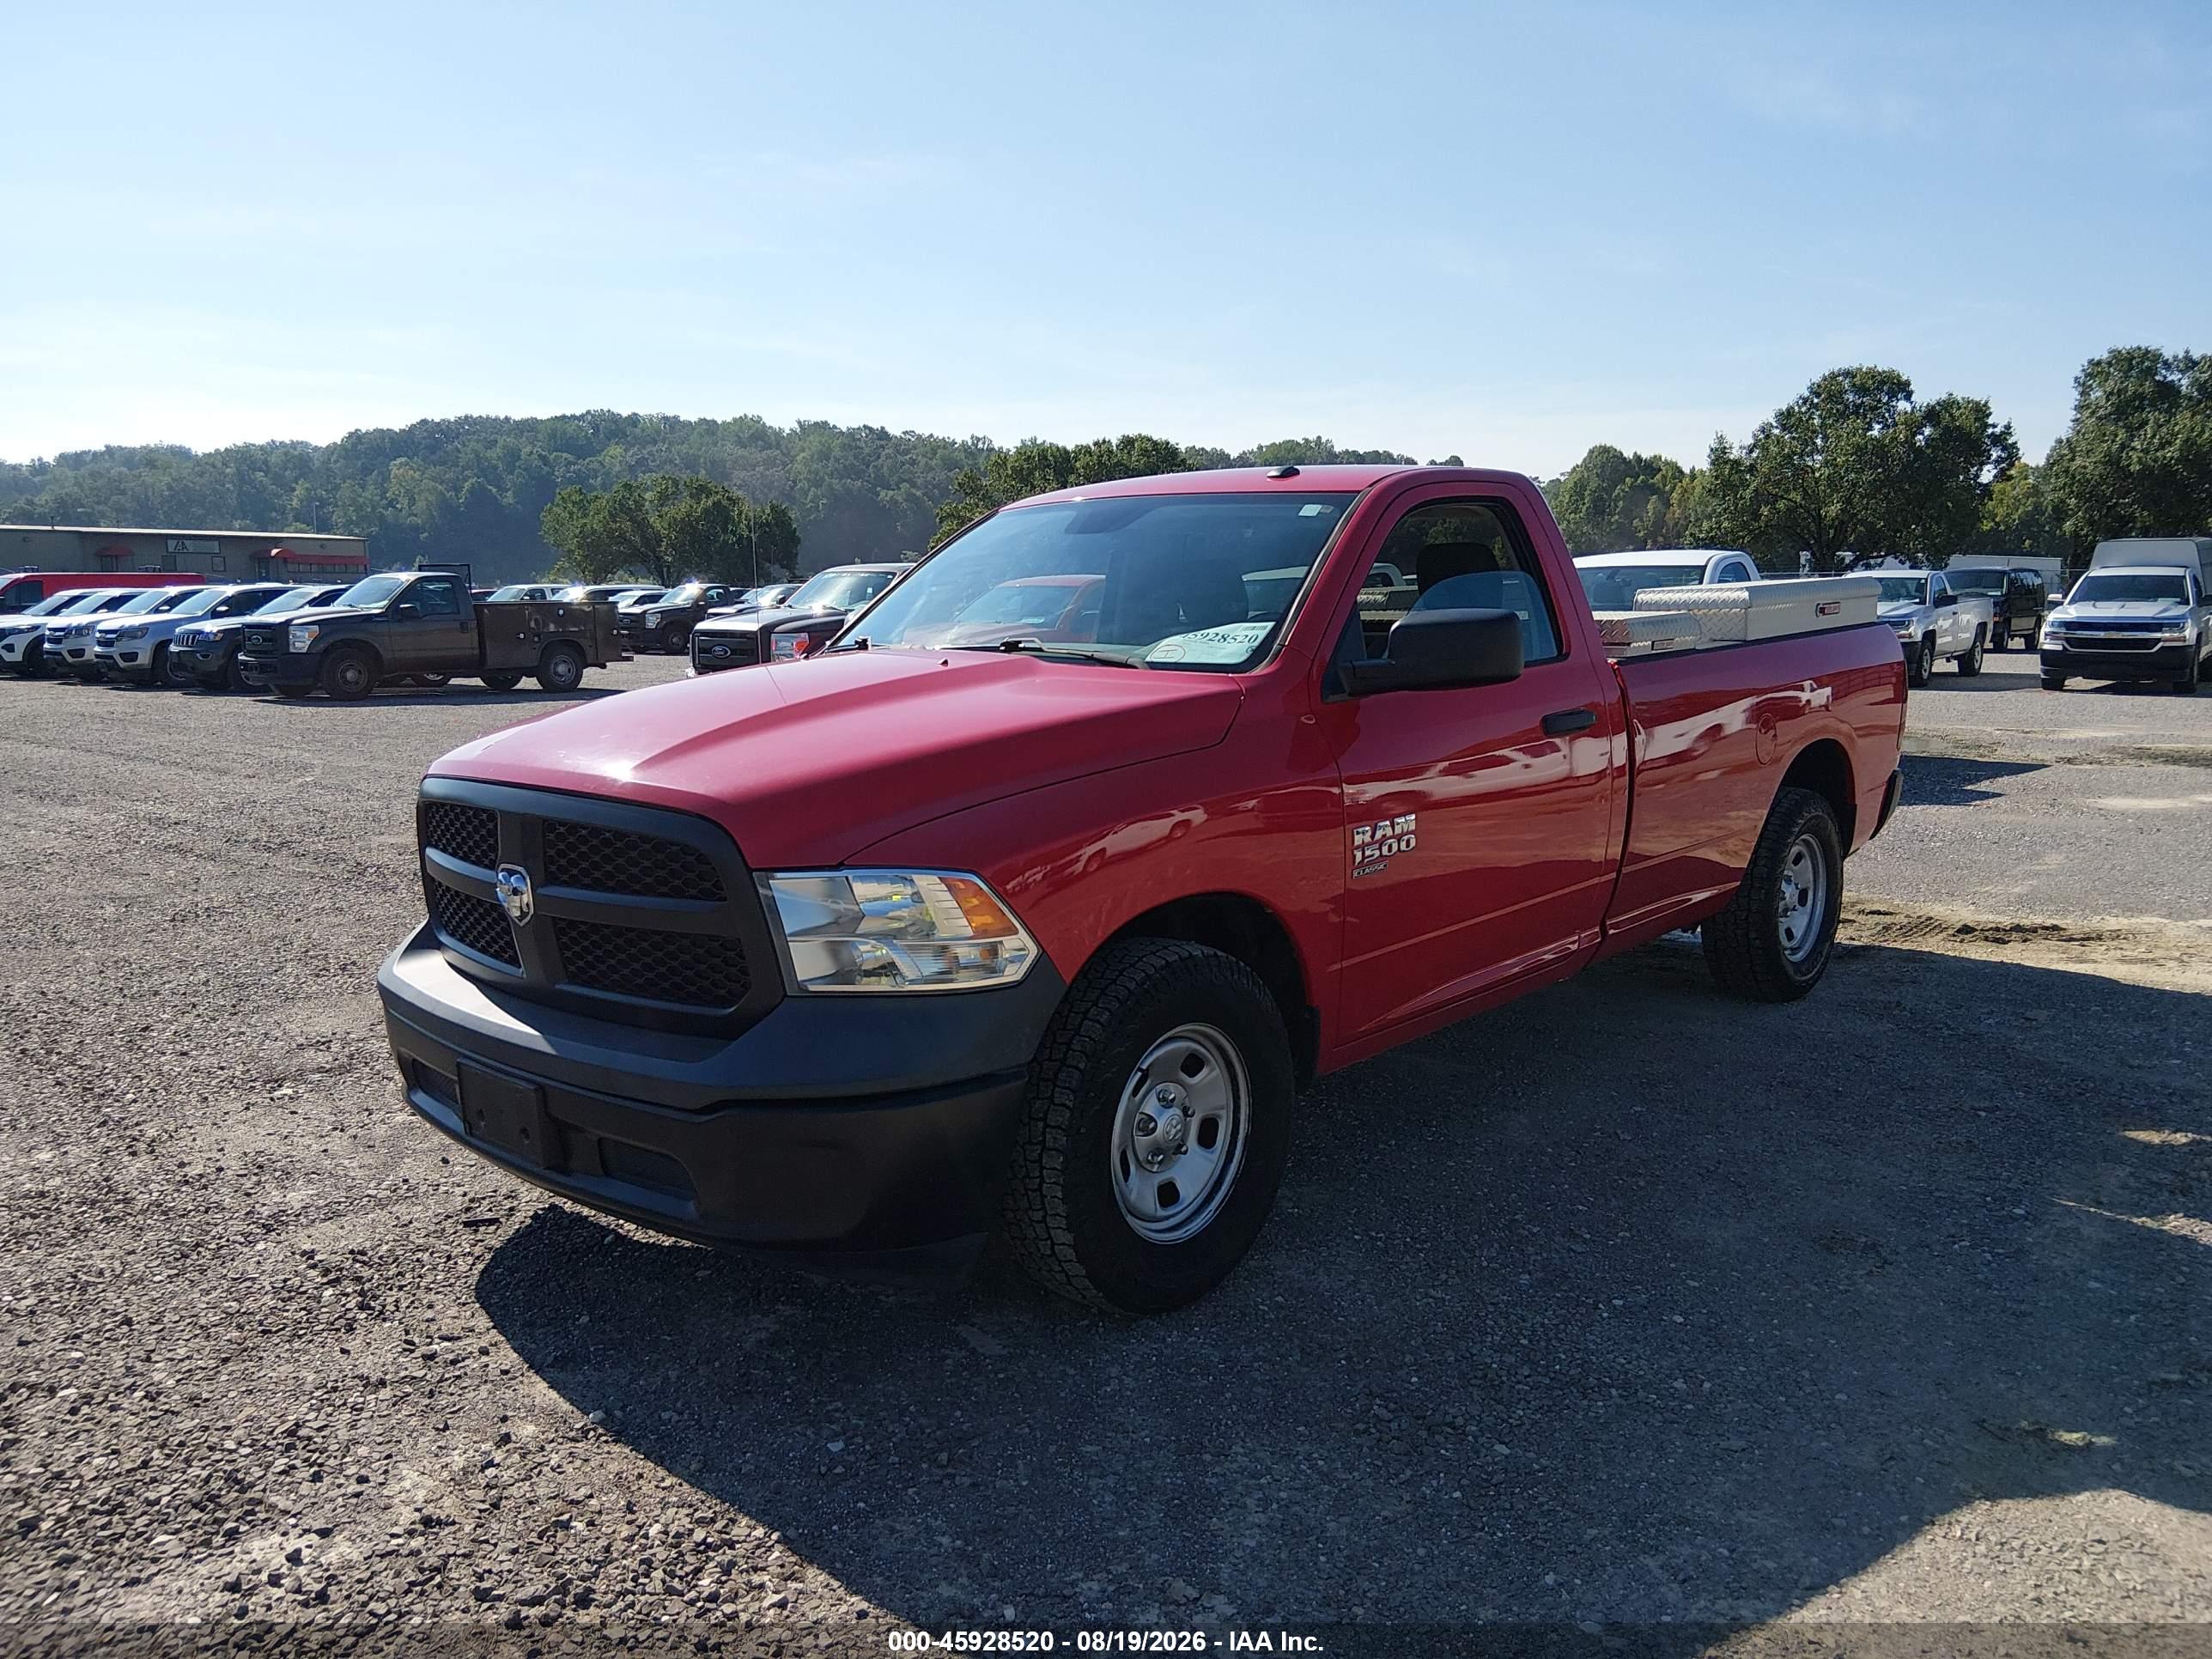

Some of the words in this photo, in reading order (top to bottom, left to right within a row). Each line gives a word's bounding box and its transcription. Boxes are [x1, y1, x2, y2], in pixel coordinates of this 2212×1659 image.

[1352, 813, 1416, 847] RAM
[1352, 834, 1416, 866] 1500
[1354, 863, 1387, 878] CLASSIC
